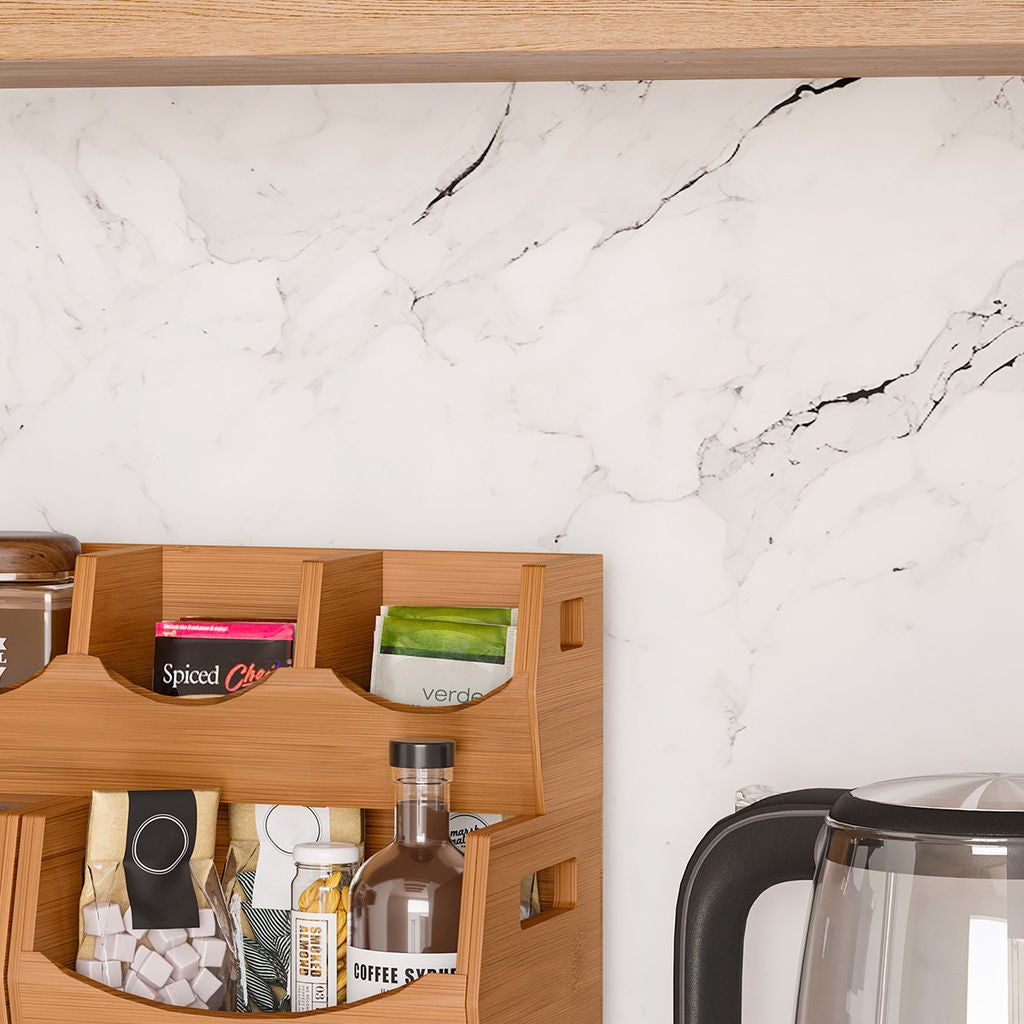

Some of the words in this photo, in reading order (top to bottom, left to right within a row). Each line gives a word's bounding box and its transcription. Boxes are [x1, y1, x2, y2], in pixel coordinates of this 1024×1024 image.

[163, 663, 219, 688] Spiced
[299, 925, 309, 976] ALMOND
[310, 926, 322, 977] SMOKED
[354, 962, 398, 984] COFFEE
